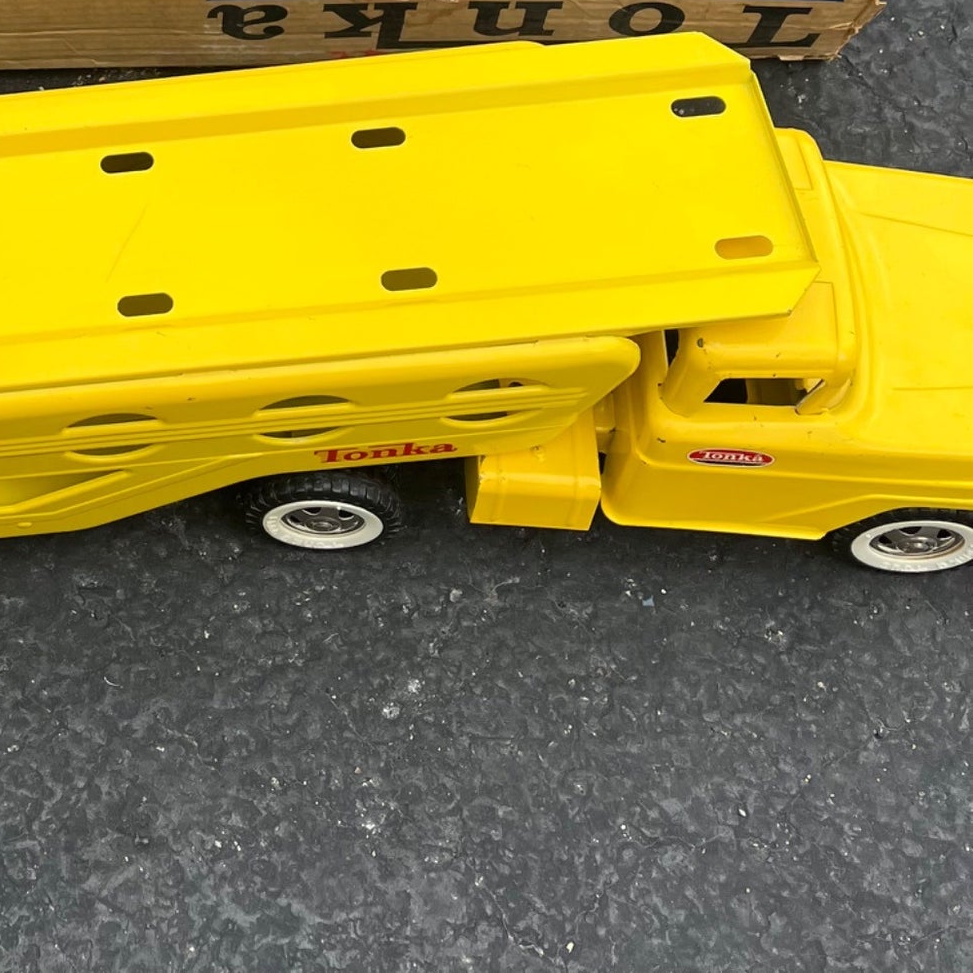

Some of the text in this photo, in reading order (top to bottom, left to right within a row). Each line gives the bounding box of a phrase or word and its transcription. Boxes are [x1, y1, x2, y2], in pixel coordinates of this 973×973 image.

[207, 2, 821, 49] Tonka
[314, 442, 458, 463] Tonka
[699, 451, 764, 462] Tonka
